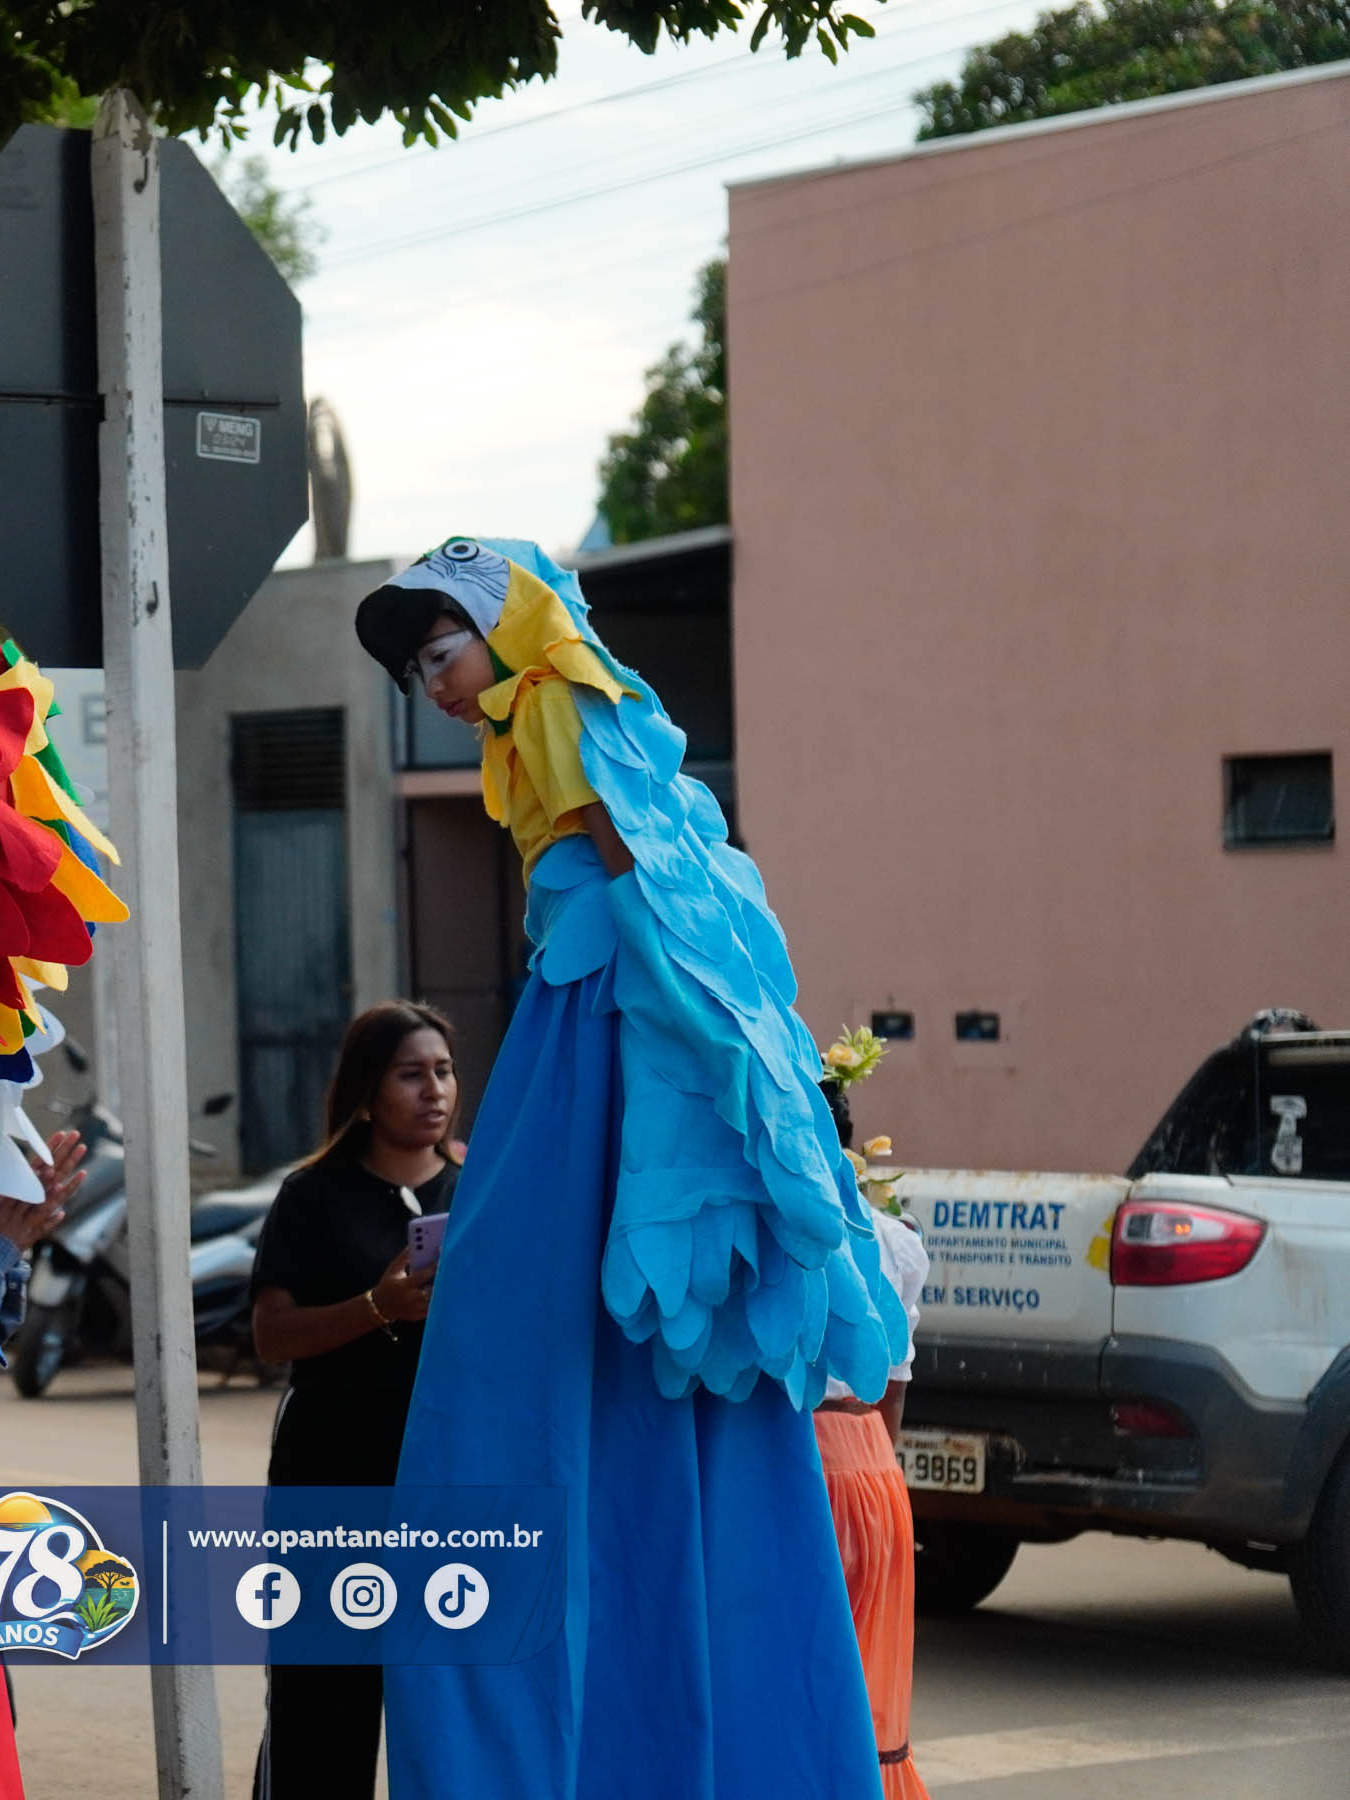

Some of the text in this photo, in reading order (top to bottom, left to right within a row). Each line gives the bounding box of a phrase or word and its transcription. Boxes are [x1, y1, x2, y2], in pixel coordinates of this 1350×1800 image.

[933, 1200, 1066, 1230] DEMTRAT
[928, 1235, 1067, 1250] DEPARTAMENTO MUNICIPAL
[939, 1252, 1004, 1264] TRANSPORTE
[1010, 1254, 1015, 1264] E
[922, 1285, 1040, 1313] EM SERVIÇO
